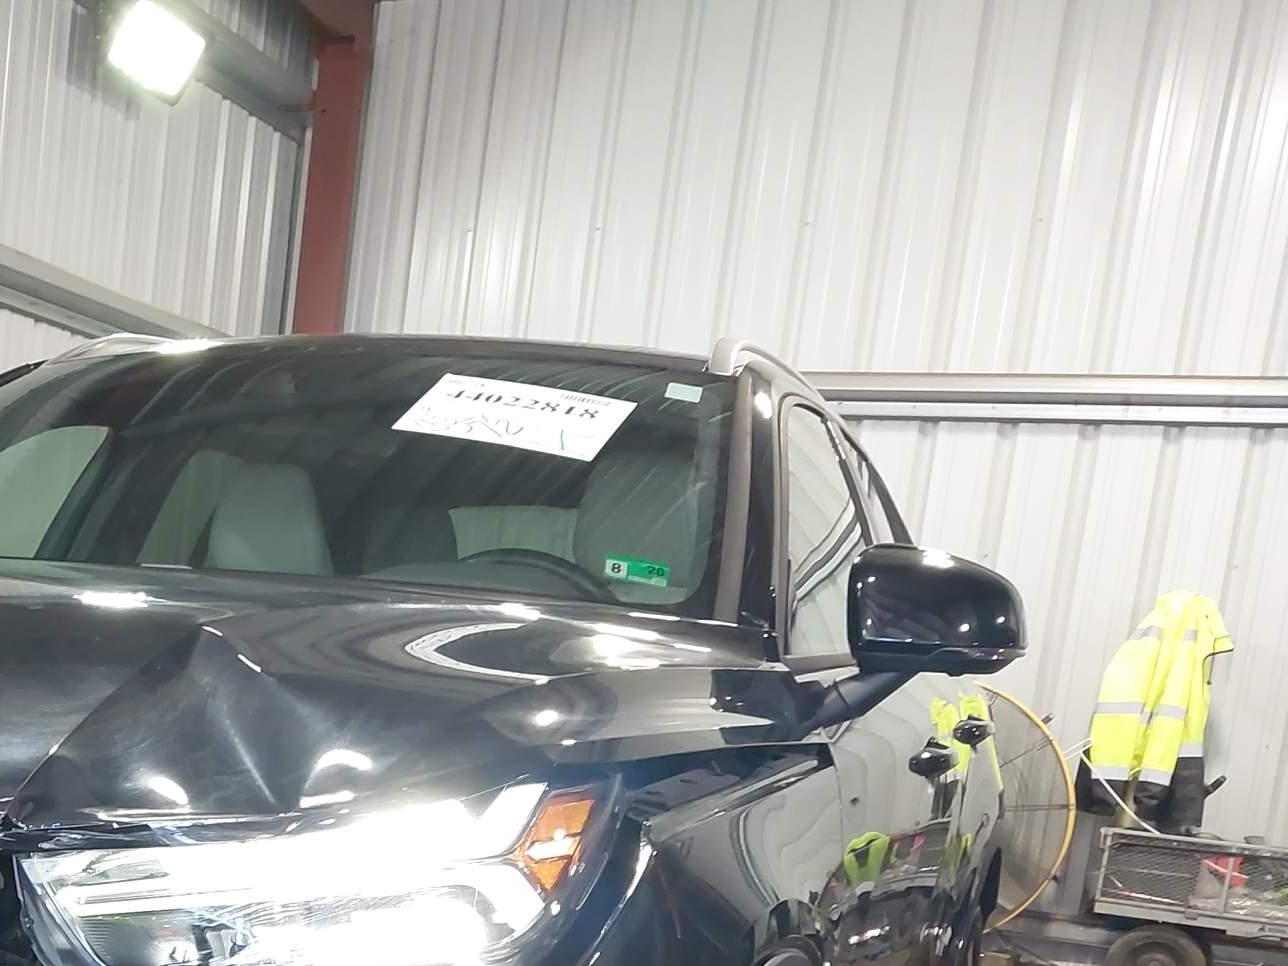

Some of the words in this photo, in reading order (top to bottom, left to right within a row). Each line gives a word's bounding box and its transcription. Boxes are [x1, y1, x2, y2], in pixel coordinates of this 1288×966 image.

[447, 389, 600, 420] 44022818
[611, 562, 622, 574] 8
[647, 565, 665, 577] 20
